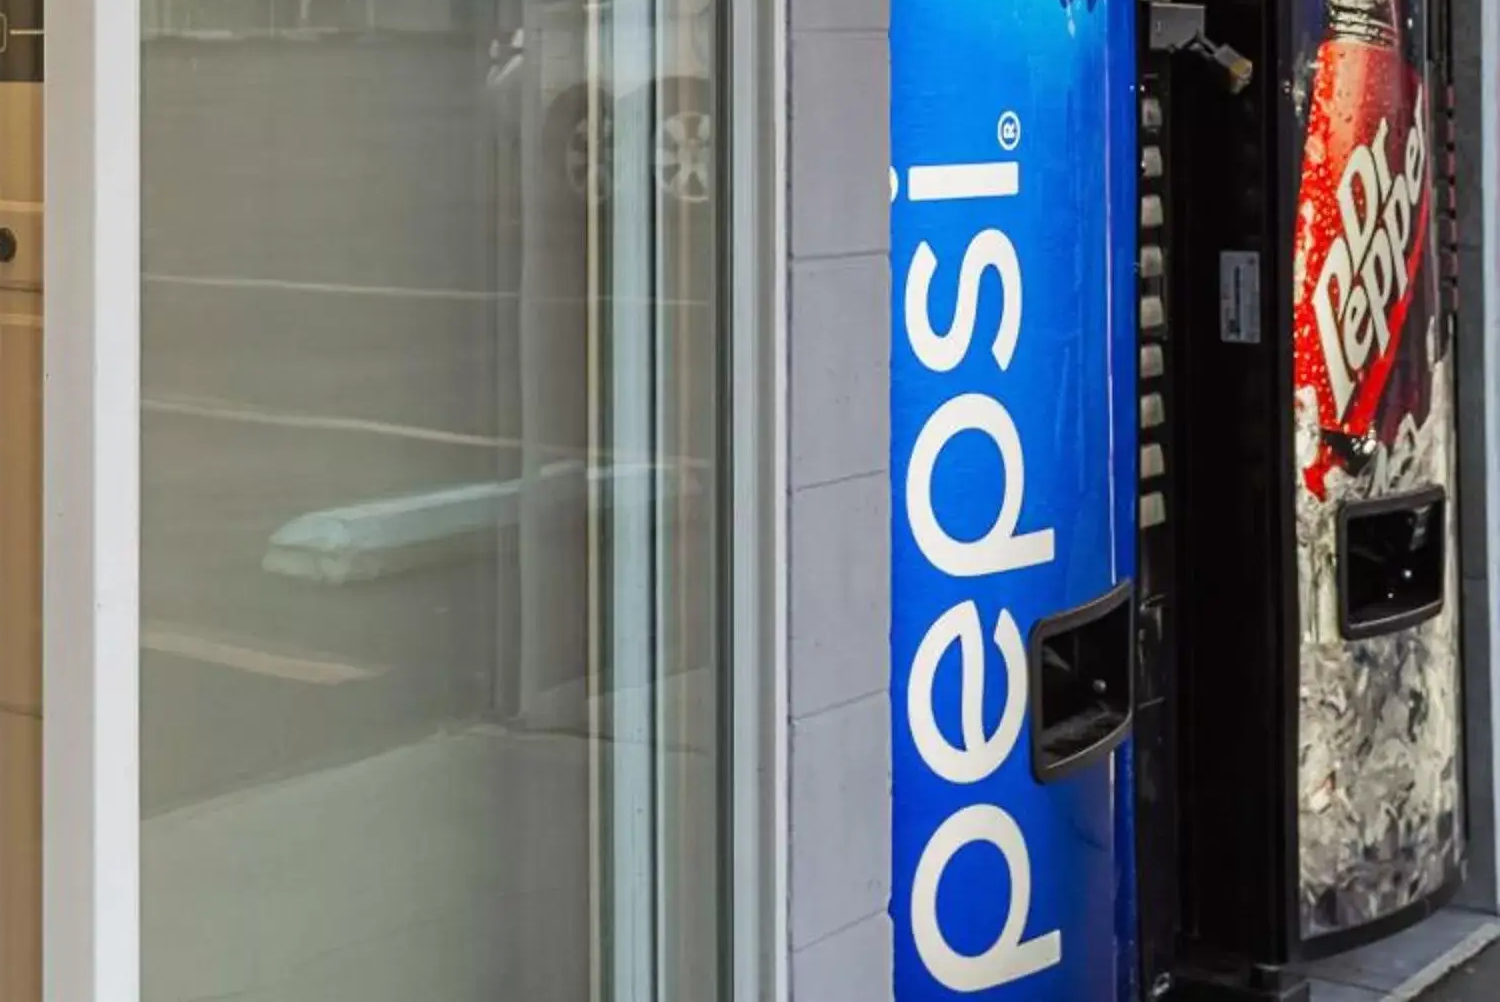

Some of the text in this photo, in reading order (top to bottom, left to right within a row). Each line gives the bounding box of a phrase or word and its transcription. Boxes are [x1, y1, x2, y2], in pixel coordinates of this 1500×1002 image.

[1312, 82, 1426, 424] Pepper
[1336, 116, 1392, 276] Dr
[889, 160, 1062, 993] pepsi
